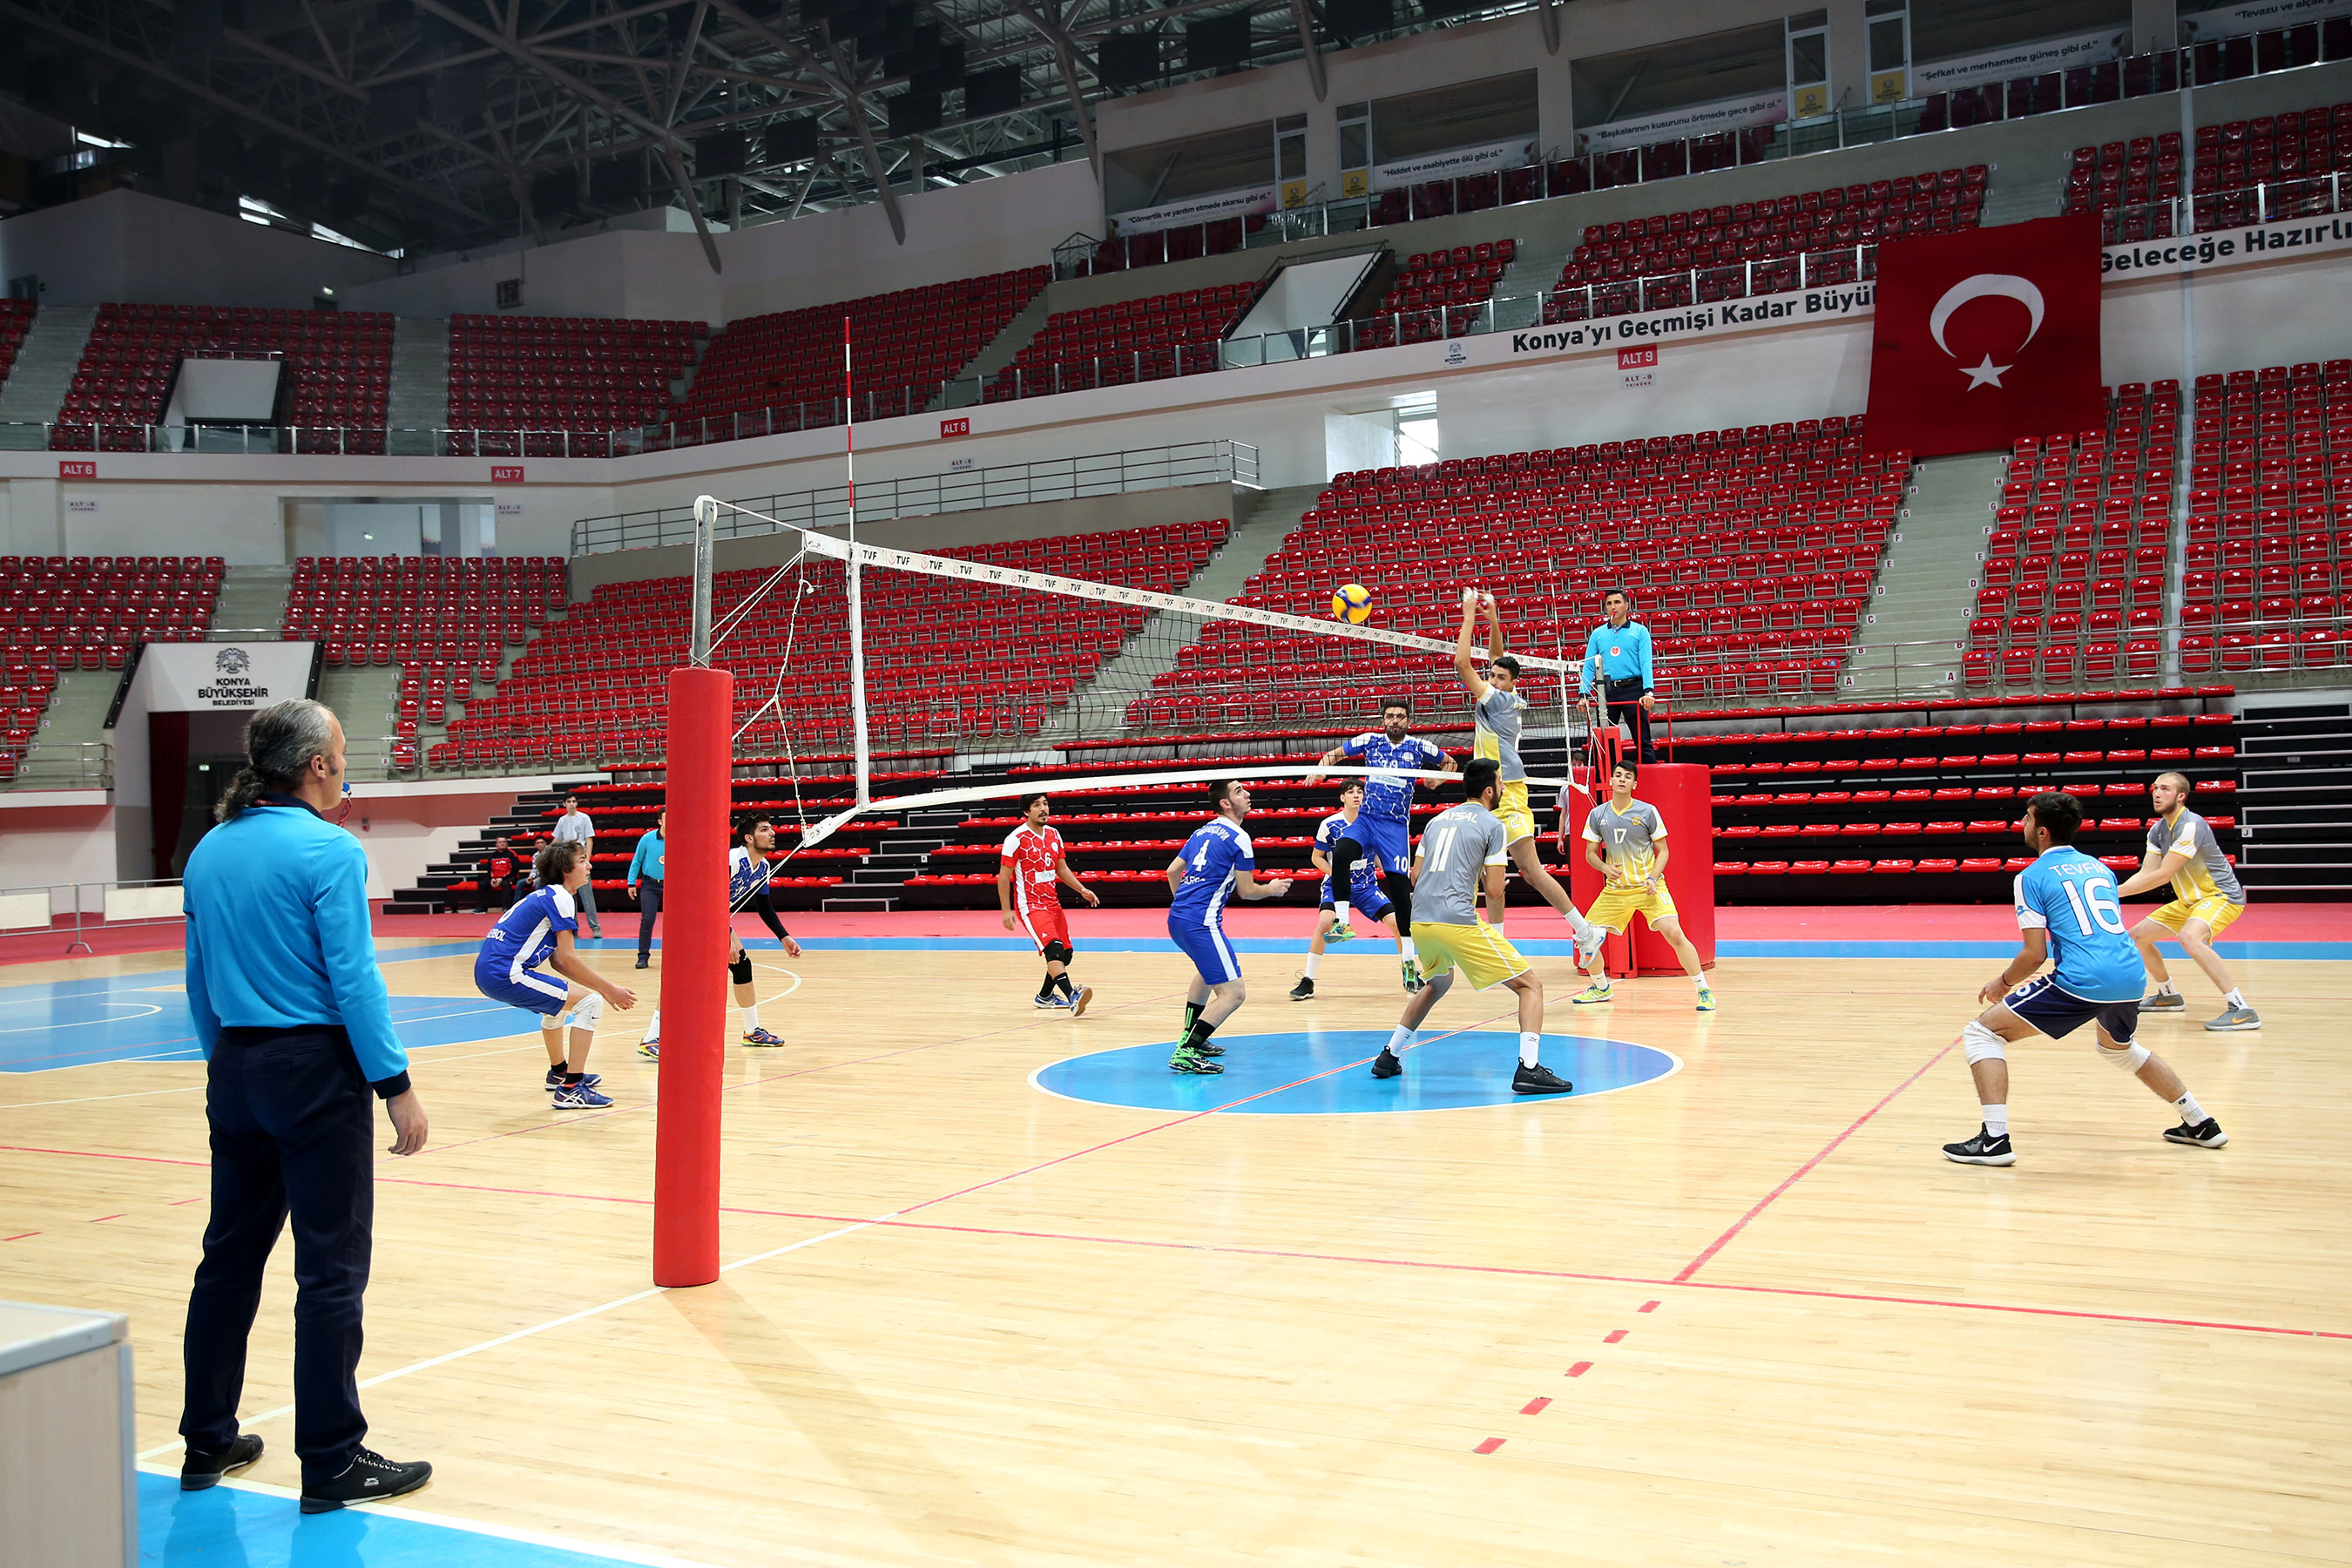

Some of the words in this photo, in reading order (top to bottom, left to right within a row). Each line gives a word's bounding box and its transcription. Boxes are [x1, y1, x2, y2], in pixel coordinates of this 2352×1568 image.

[2279, 3, 2294, 11] ve
[1970, 54, 2027, 71] merhamette
[2030, 50, 2059, 63] güneş
[2061, 43, 2079, 57] gibi
[1651, 117, 1691, 129] kusurunu
[1692, 110, 1727, 124] örtmede
[1727, 106, 1747, 118] gece
[1749, 101, 1766, 114] gibi
[1423, 158, 1460, 170] asabiyette
[1462, 154, 1473, 163] ölü
[1475, 152, 1489, 163] gibi
[1172, 206, 1195, 218] yardım
[1195, 201, 1221, 212] etmede
[1221, 197, 1245, 207] akarsu
[1245, 193, 1258, 204] gibi
[1618, 308, 1714, 338] Geçmişi
[1721, 301, 1797, 325] Kadar
[1805, 285, 1876, 314] Büyü
[2101, 236, 2235, 274] Geleceğe
[1622, 352, 1643, 366] ALT
[1645, 350, 1653, 362] 9
[943, 422, 959, 434] ALT
[961, 422, 967, 432] 8
[64, 465, 84, 475] ALT
[84, 465, 93, 475] 6
[495, 469, 512, 479] ALT
[514, 469, 522, 479] 7
[863, 550, 877, 561] TVF
[896, 555, 910, 565] TVF
[929, 560, 943, 571] TVF
[960, 565, 973, 575] TVF
[990, 571, 1002, 580] TVF
[1018, 574, 1030, 584] TVF
[1045, 579, 1057, 588] TVF
[1071, 583, 1082, 592] TVF
[1095, 587, 1106, 596] TVF
[198, 686, 269, 699] BÜYÜKŞEHİR
[1508, 813, 1521, 829] 2
[1613, 828, 1627, 844] 17
[1192, 839, 1210, 872] 4
[1429, 826, 1458, 873] 11
[1044, 852, 1051, 867] 6
[1394, 855, 1408, 873] 10
[2048, 860, 2110, 877] TEVFİK
[1660, 893, 1672, 905] 17
[2061, 876, 2126, 936] 16
[2195, 900, 2213, 910] 3
